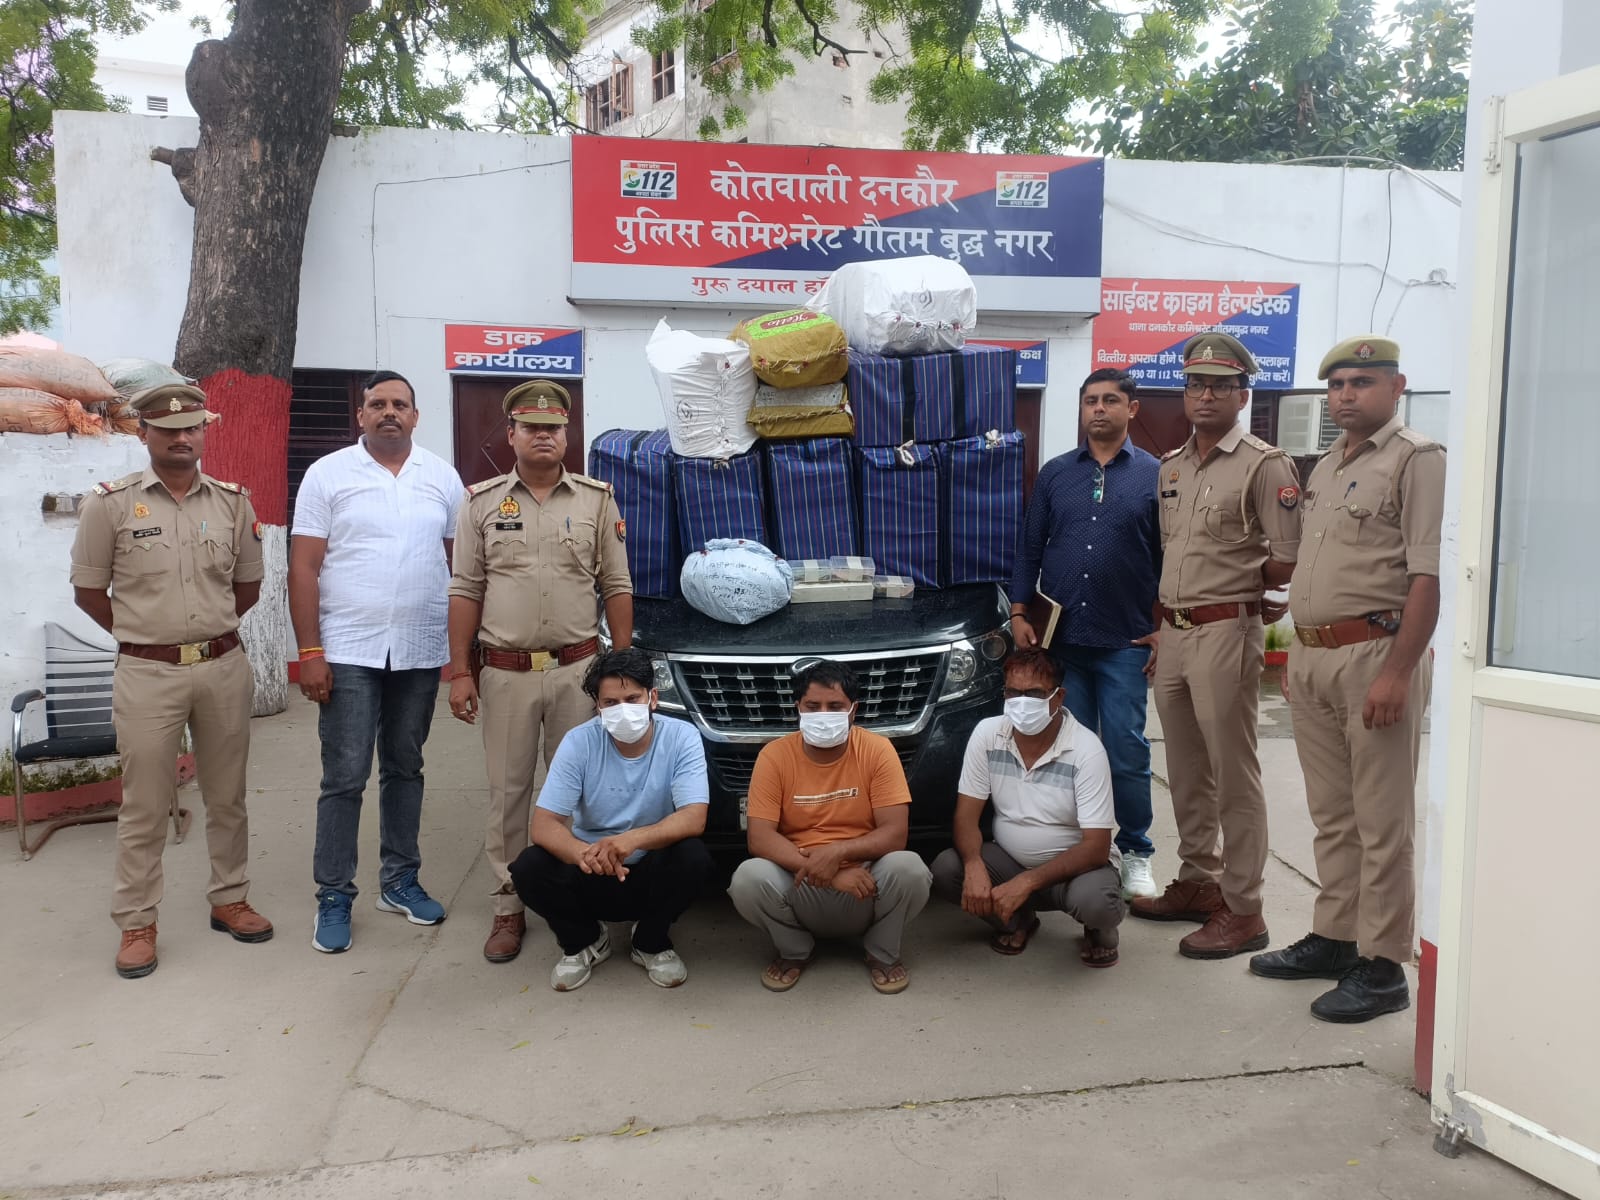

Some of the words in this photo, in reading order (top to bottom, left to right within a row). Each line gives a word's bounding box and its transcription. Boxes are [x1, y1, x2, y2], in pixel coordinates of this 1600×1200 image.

[642, 171, 675, 190] 112
[710, 160, 852, 204] कोतवाली
[860, 164, 959, 212] दनकौर
[1016, 181, 1047, 199] 112
[614, 206, 704, 254] पुलिस
[711, 210, 846, 256] कमिश्नरेट
[853, 213, 934, 254] गौतम
[940, 228, 988, 263] बुद्ध
[994, 230, 1053, 262] नगर
[692, 277, 730, 296] गुरू
[737, 279, 798, 294] दयाल
[1103, 282, 1159, 315] साईबर
[1162, 289, 1214, 317] क्राइम
[483, 330, 545, 346] डाक
[453, 348, 574, 370] कार्यालय
[1159, 351, 1177, 365] होने
[1146, 369, 1157, 380] या
[1158, 370, 1171, 380] 112
